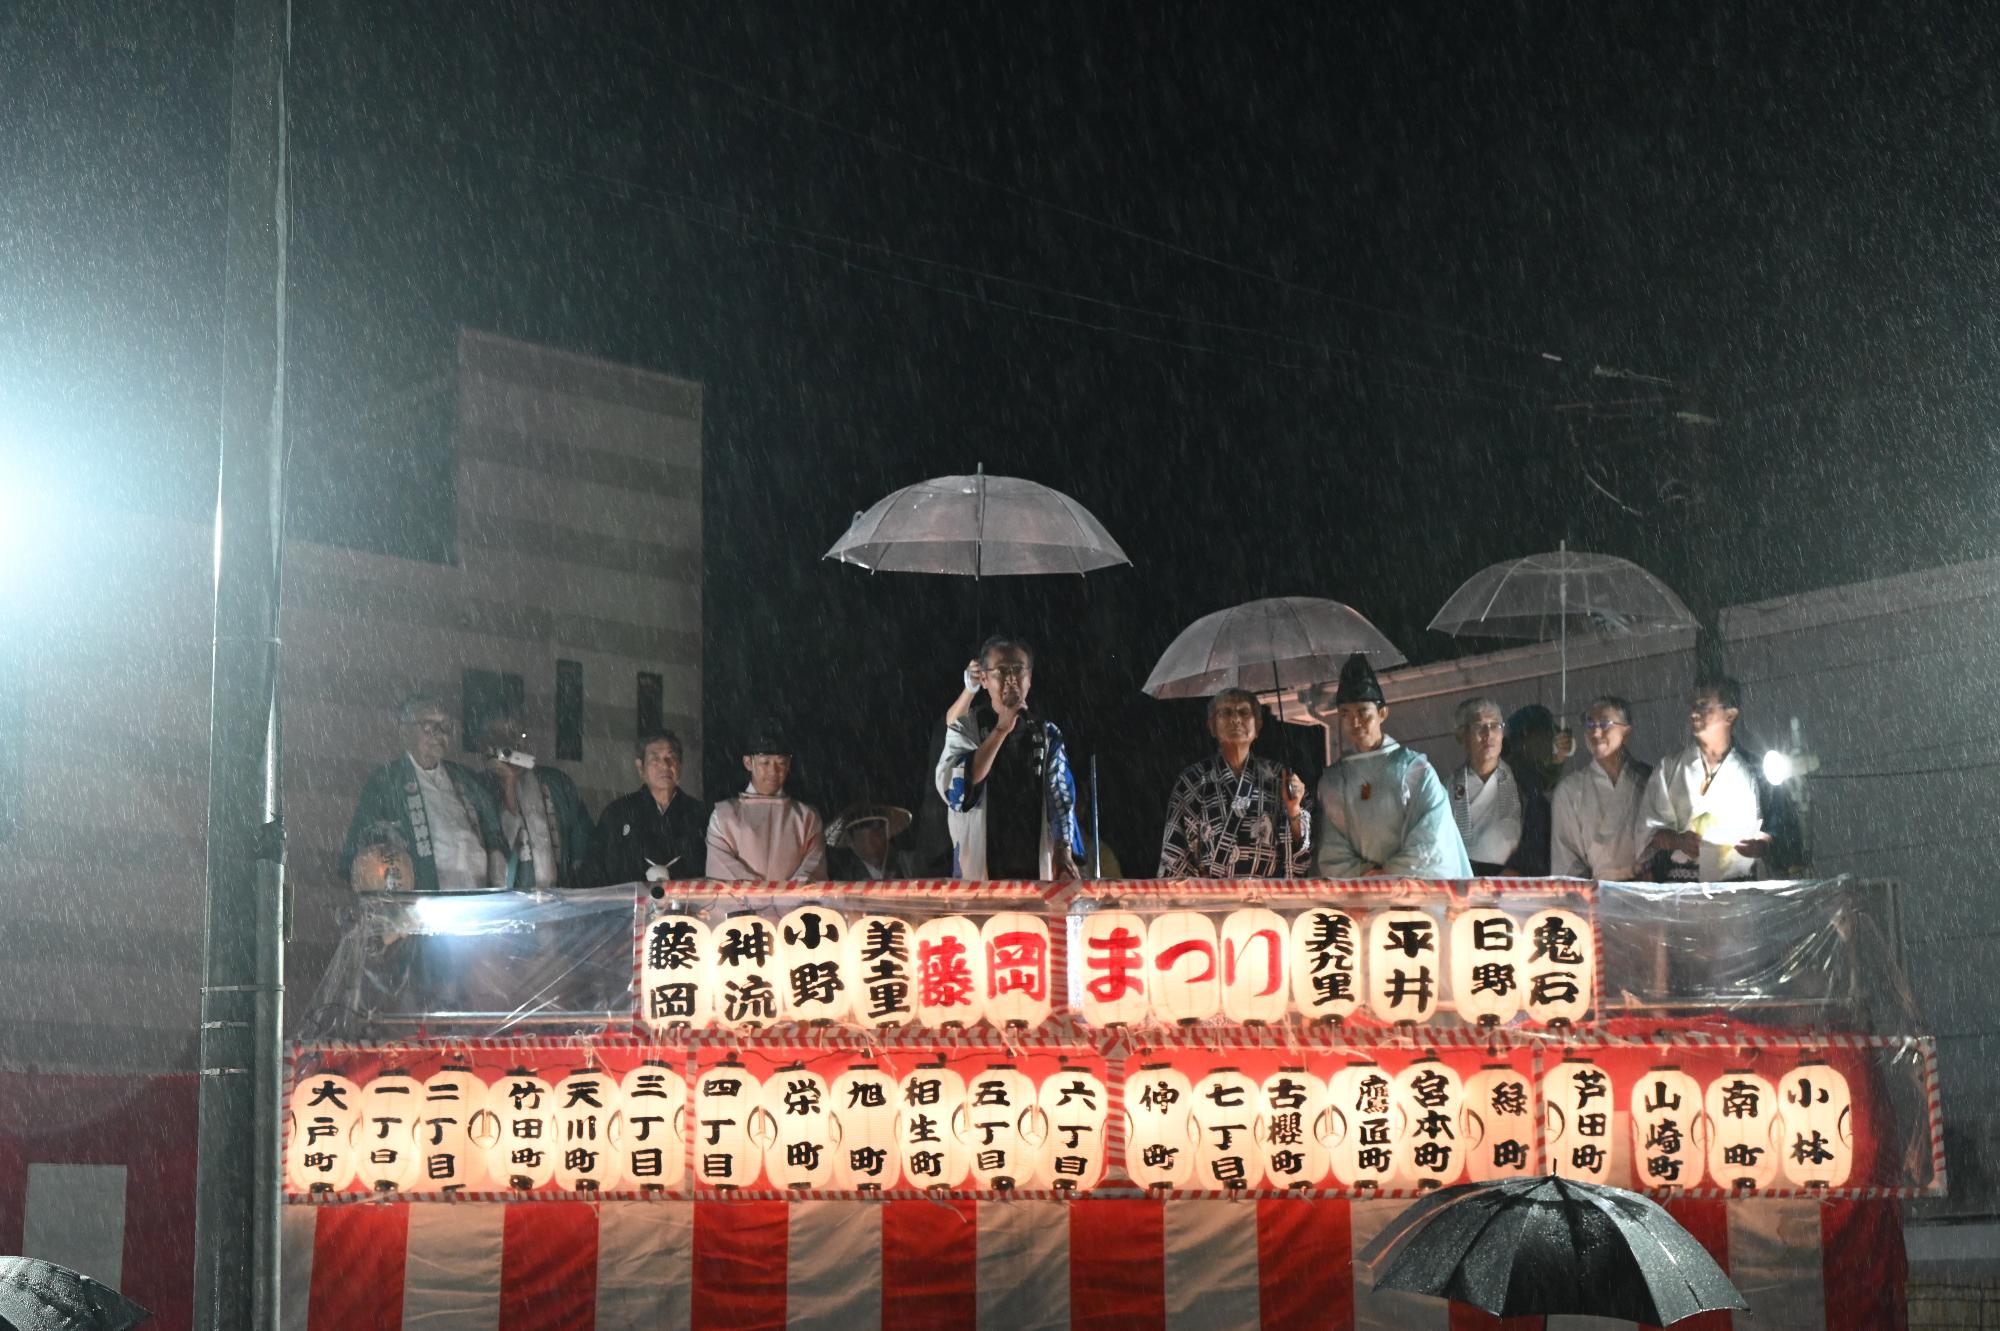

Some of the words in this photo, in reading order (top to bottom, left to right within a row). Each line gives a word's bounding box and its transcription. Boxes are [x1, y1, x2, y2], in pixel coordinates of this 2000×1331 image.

[649, 921, 700, 1019] 藤岡
[717, 922, 776, 1020] 神流
[783, 912, 845, 1006] 小野
[861, 920, 911, 1019] 美土里
[1305, 912, 1356, 1006] 美九里
[1384, 920, 1435, 1010] 平井
[1471, 918, 1517, 997] 日野
[1527, 916, 1585, 1006] 鬼石
[304, 1080, 348, 1171] 大戸町
[370, 1085, 410, 1164] 一丁目
[425, 1083, 460, 1179] 二丁目
[508, 1081, 545, 1168] 竹田町
[564, 1080, 602, 1173] 天川町
[630, 1075, 668, 1177] 三丁目
[700, 1079, 742, 1178] 四丁目
[784, 1079, 825, 1171] 栄町
[846, 1080, 887, 1177] 旭町
[903, 1076, 945, 1177] 相生町
[973, 1080, 1011, 1172] 五丁目
[1055, 1080, 1097, 1176] 六丁目
[1139, 1080, 1179, 1170] 仲町
[1205, 1083, 1247, 1181] 七丁目
[1356, 1074, 1393, 1173] 鷹匠町
[1410, 1069, 1455, 1173] 宮本町
[1491, 1081, 1530, 1170] 緑町
[1571, 1069, 1607, 1174] 芦田町
[1644, 1081, 1684, 1180] 山崎町
[1722, 1080, 1764, 1168] 南町
[1787, 1078, 1834, 1165] 小林
